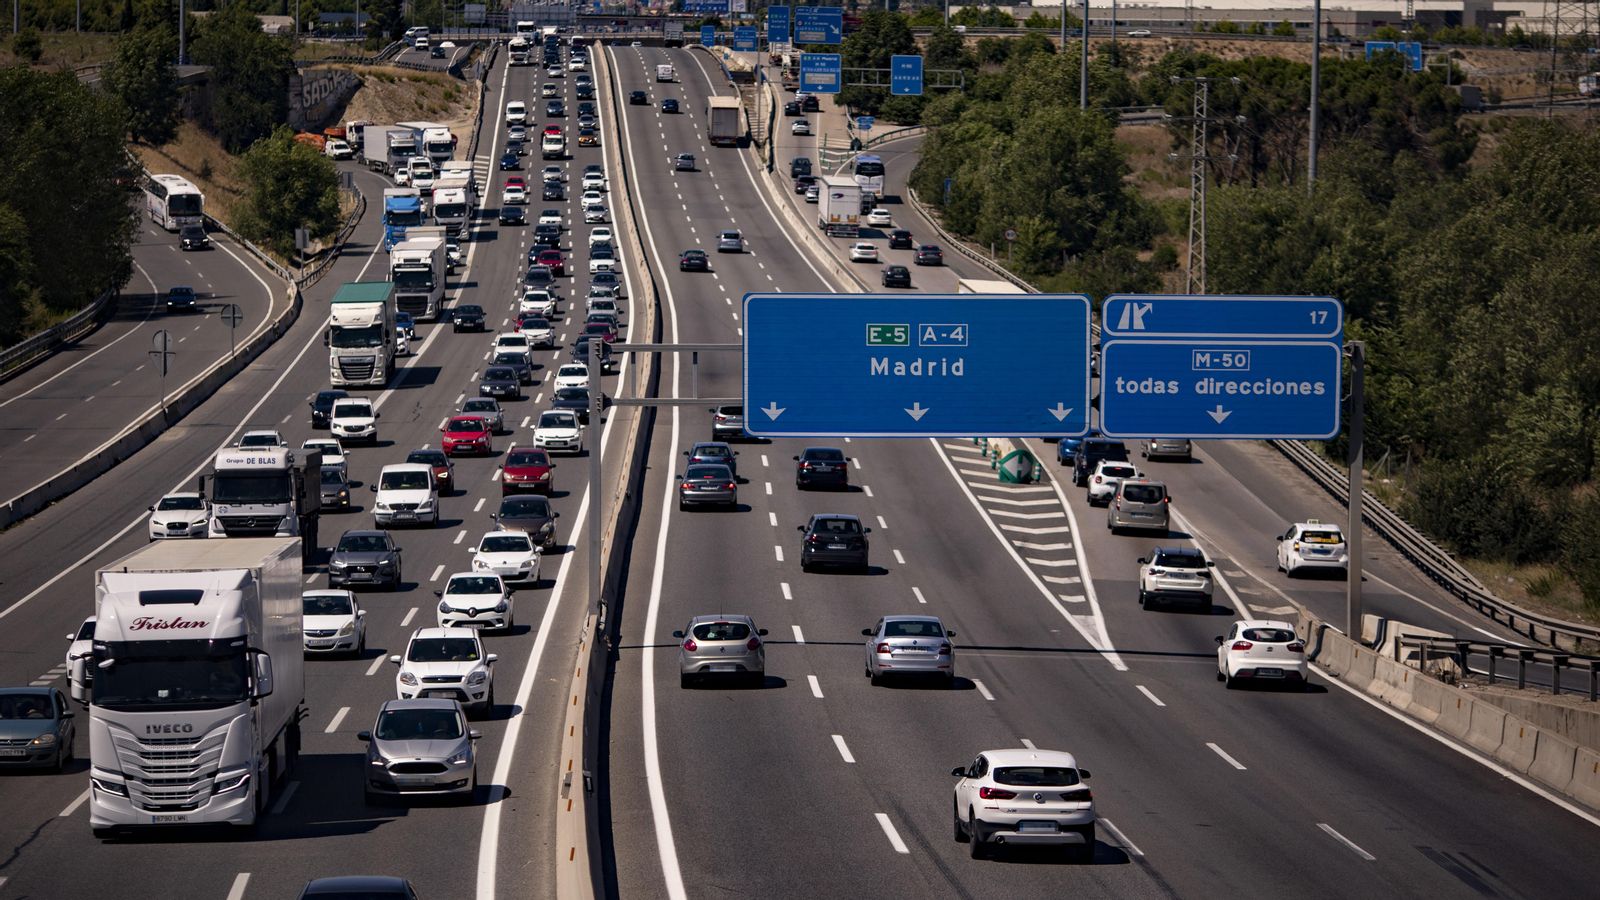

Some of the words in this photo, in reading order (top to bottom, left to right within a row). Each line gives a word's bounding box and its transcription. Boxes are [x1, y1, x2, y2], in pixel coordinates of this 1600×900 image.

[1309, 310, 1328, 325] 17
[869, 327, 906, 343] E-5
[923, 326, 964, 342] A-4
[870, 357, 964, 376] Madrid
[1195, 353, 1246, 368] M-50
[1115, 376, 1179, 394] todas
[1195, 377, 1326, 395] direcciones
[246, 457, 256, 465] DE
[258, 457, 276, 465] BLAS
[129, 616, 210, 632] Tristan
[146, 723, 193, 734] IVECO
